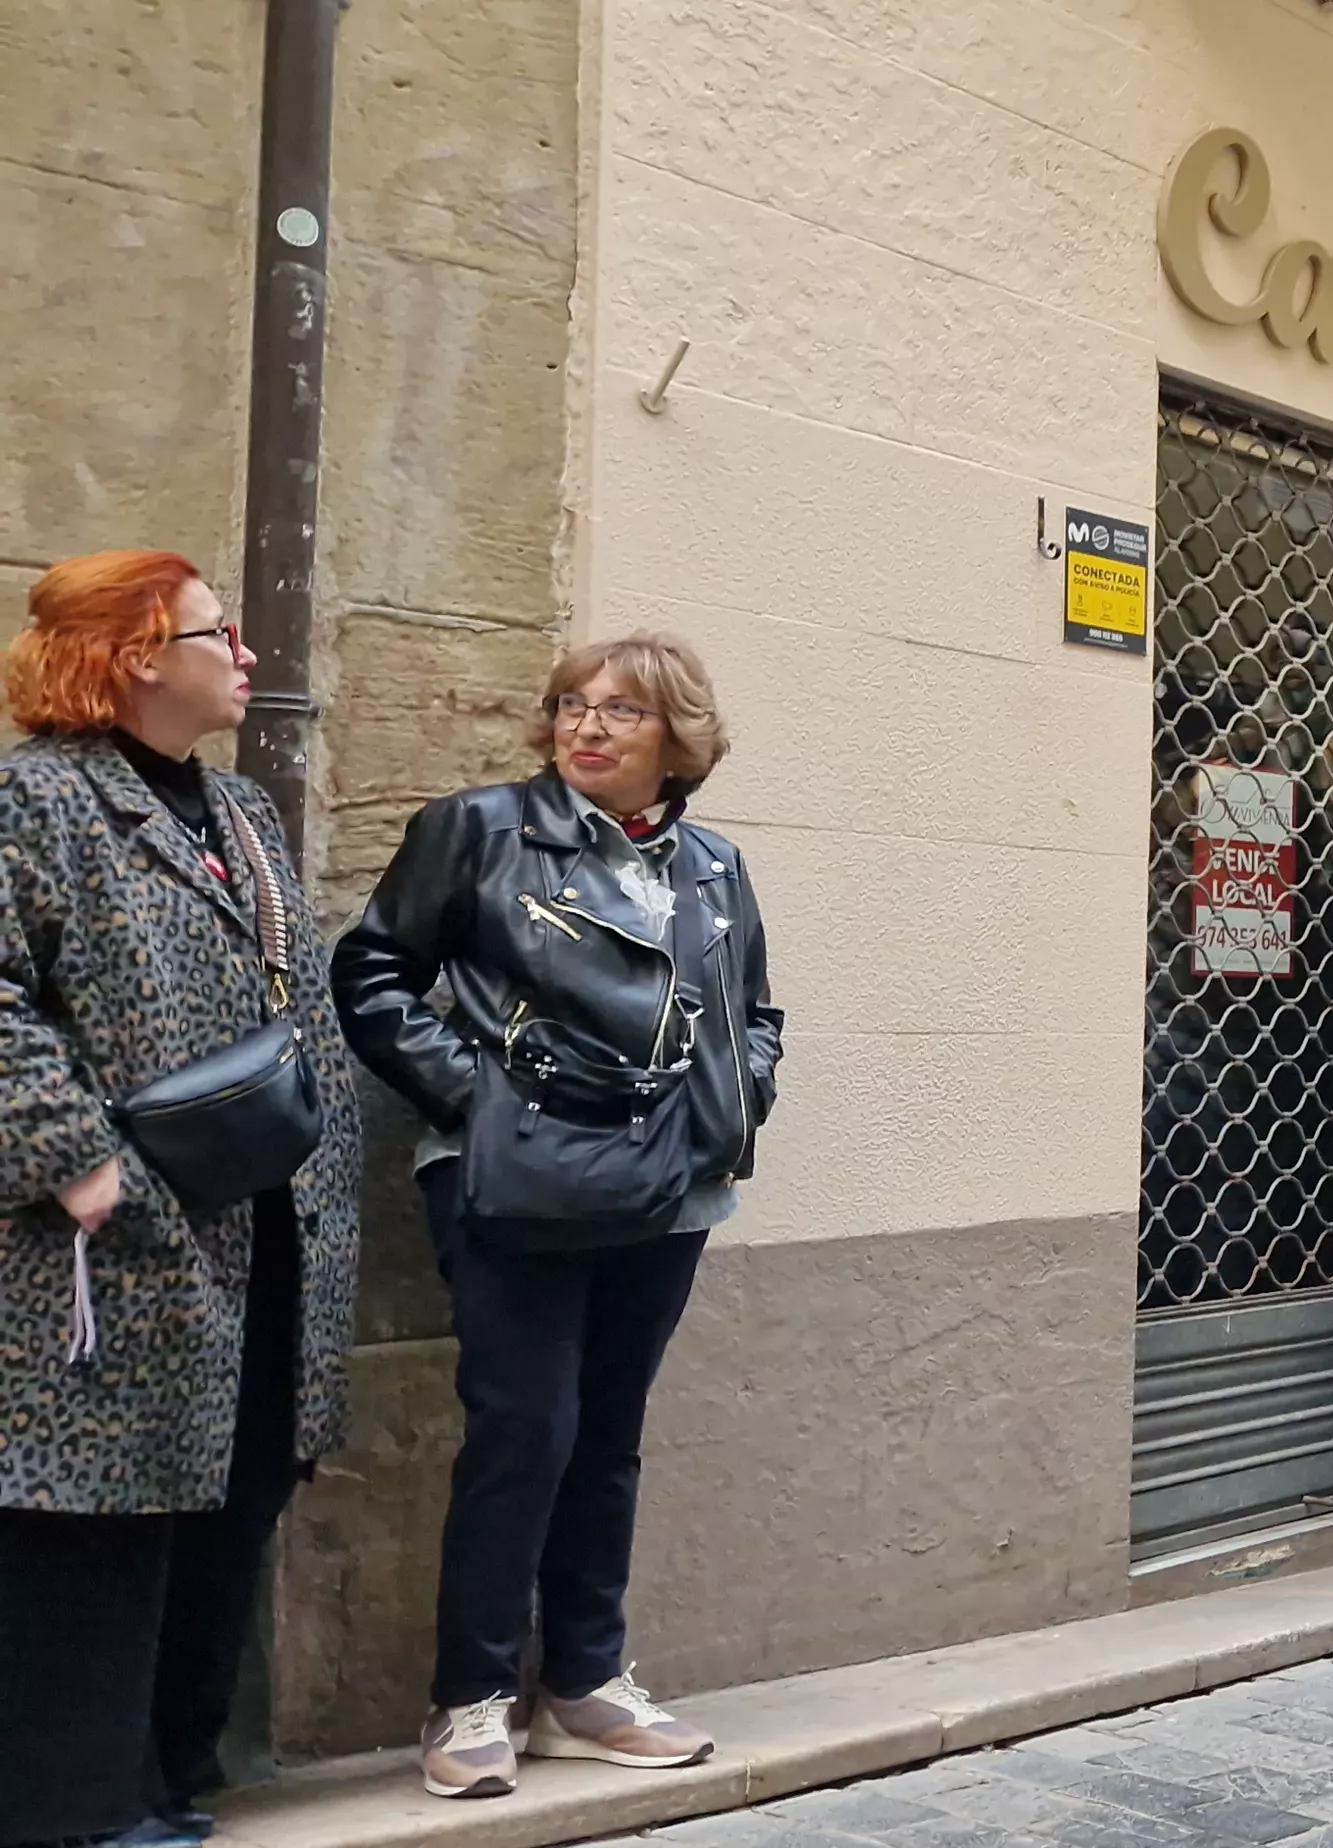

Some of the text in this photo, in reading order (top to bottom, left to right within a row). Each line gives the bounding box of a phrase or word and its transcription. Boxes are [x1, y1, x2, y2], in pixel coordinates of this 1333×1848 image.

[1073, 563, 1140, 588] CONECTADA
[1212, 879, 1277, 906] LOCAL
[1198, 925, 1226, 949] 974
